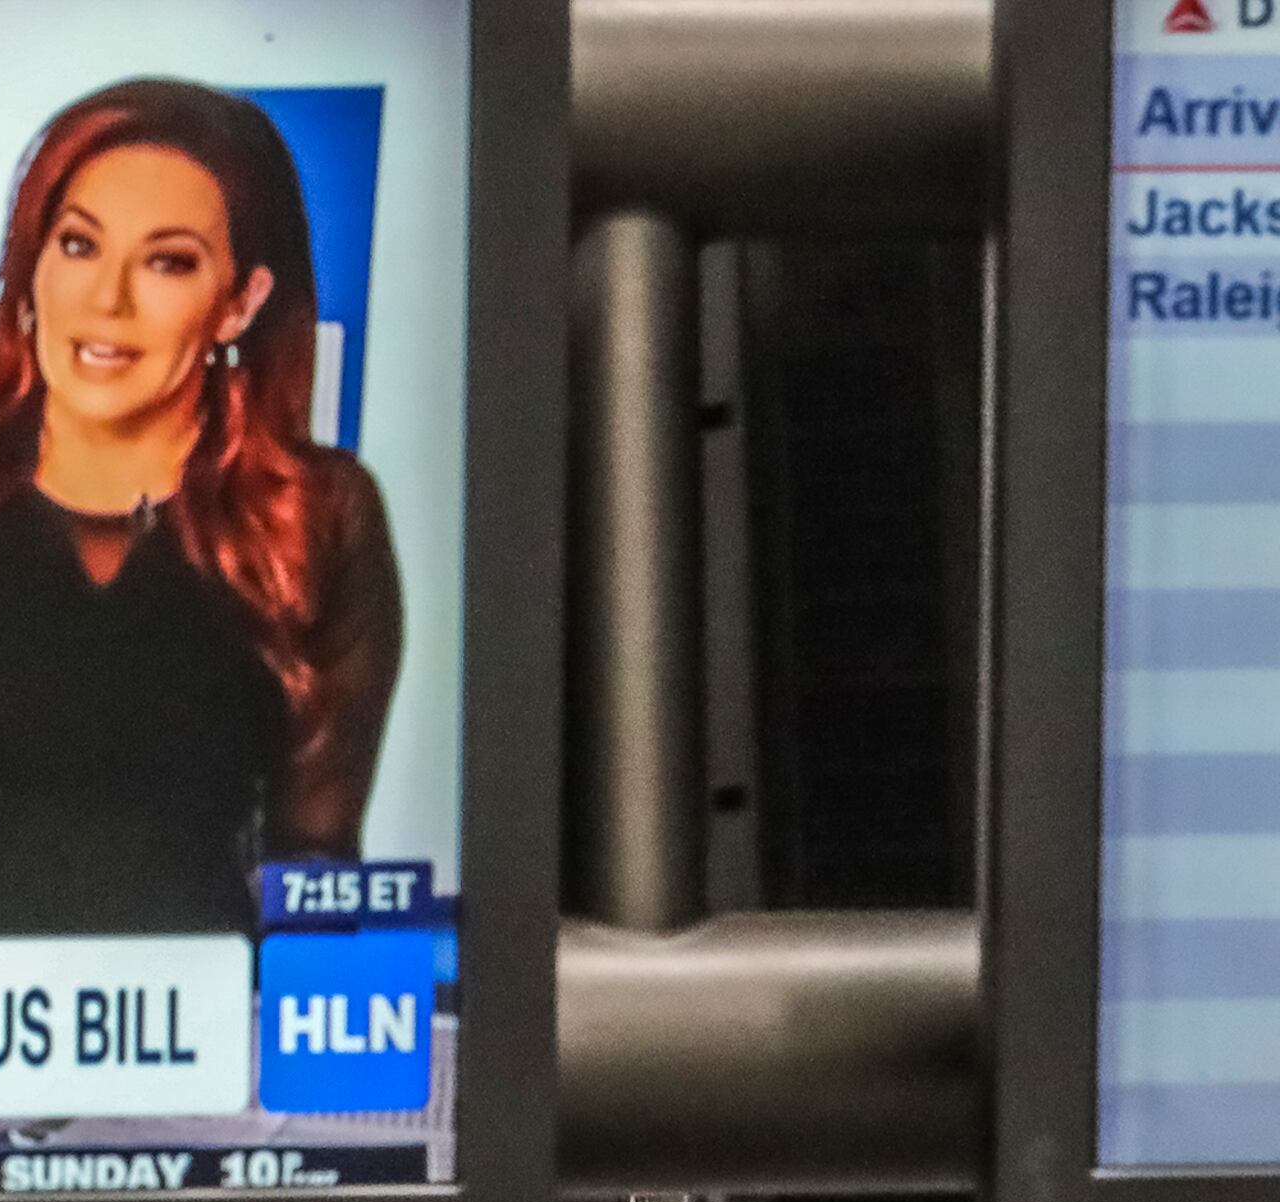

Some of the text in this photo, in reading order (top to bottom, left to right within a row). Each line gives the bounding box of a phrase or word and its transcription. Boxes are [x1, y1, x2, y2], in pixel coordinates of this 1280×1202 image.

[1137, 85, 1280, 137] Arriv
[1127, 270, 1280, 322] Ralei
[282, 871, 417, 913] 7:15 ET
[75, 988, 197, 1066] BILL
[280, 994, 416, 1055] HLN
[1, 1152, 192, 1192] SUNDAY
